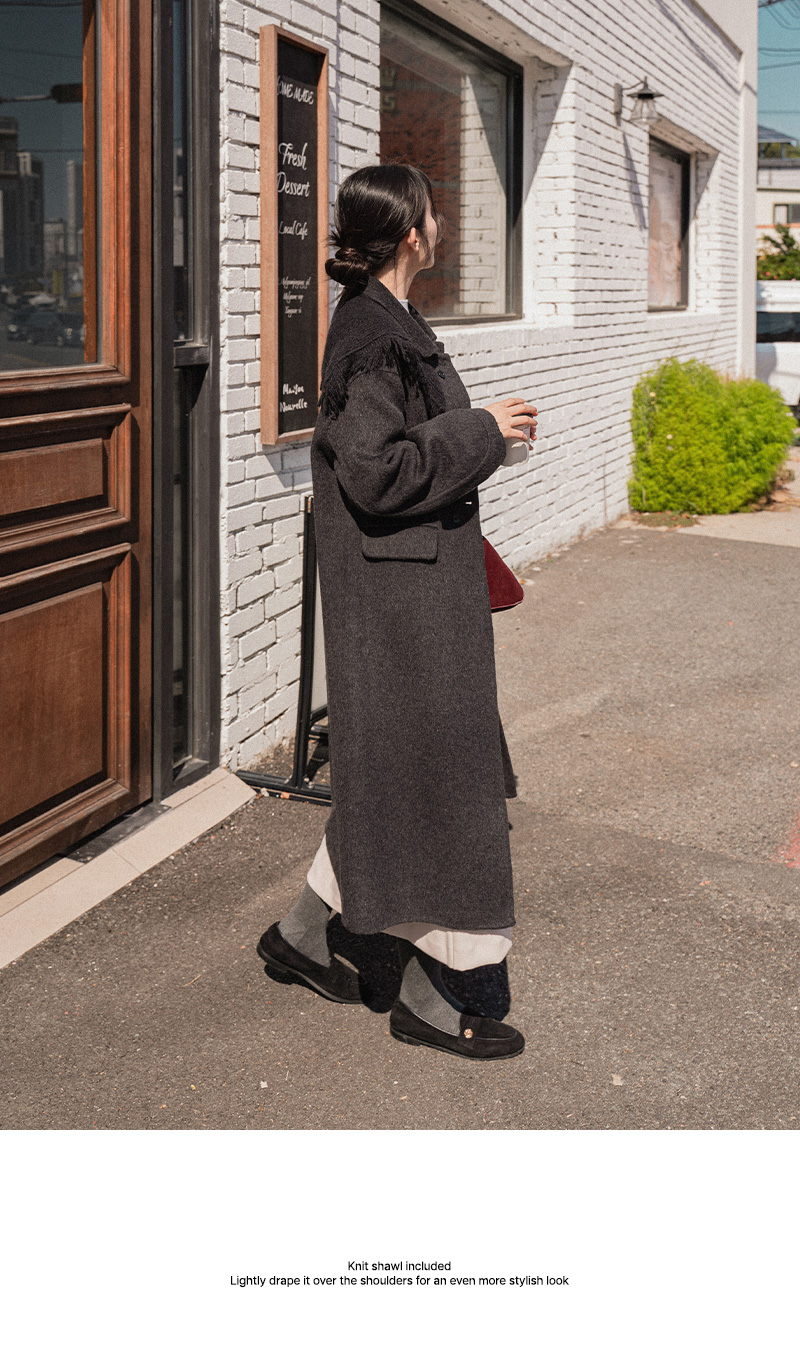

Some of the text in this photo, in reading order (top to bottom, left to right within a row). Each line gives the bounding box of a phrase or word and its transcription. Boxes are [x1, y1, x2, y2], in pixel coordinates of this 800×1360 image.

[293, 87, 314, 105] MADE
[279, 142, 308, 171] Fresh
[277, 171, 310, 197] Dessert
[279, 220, 308, 240] Local Cafe
